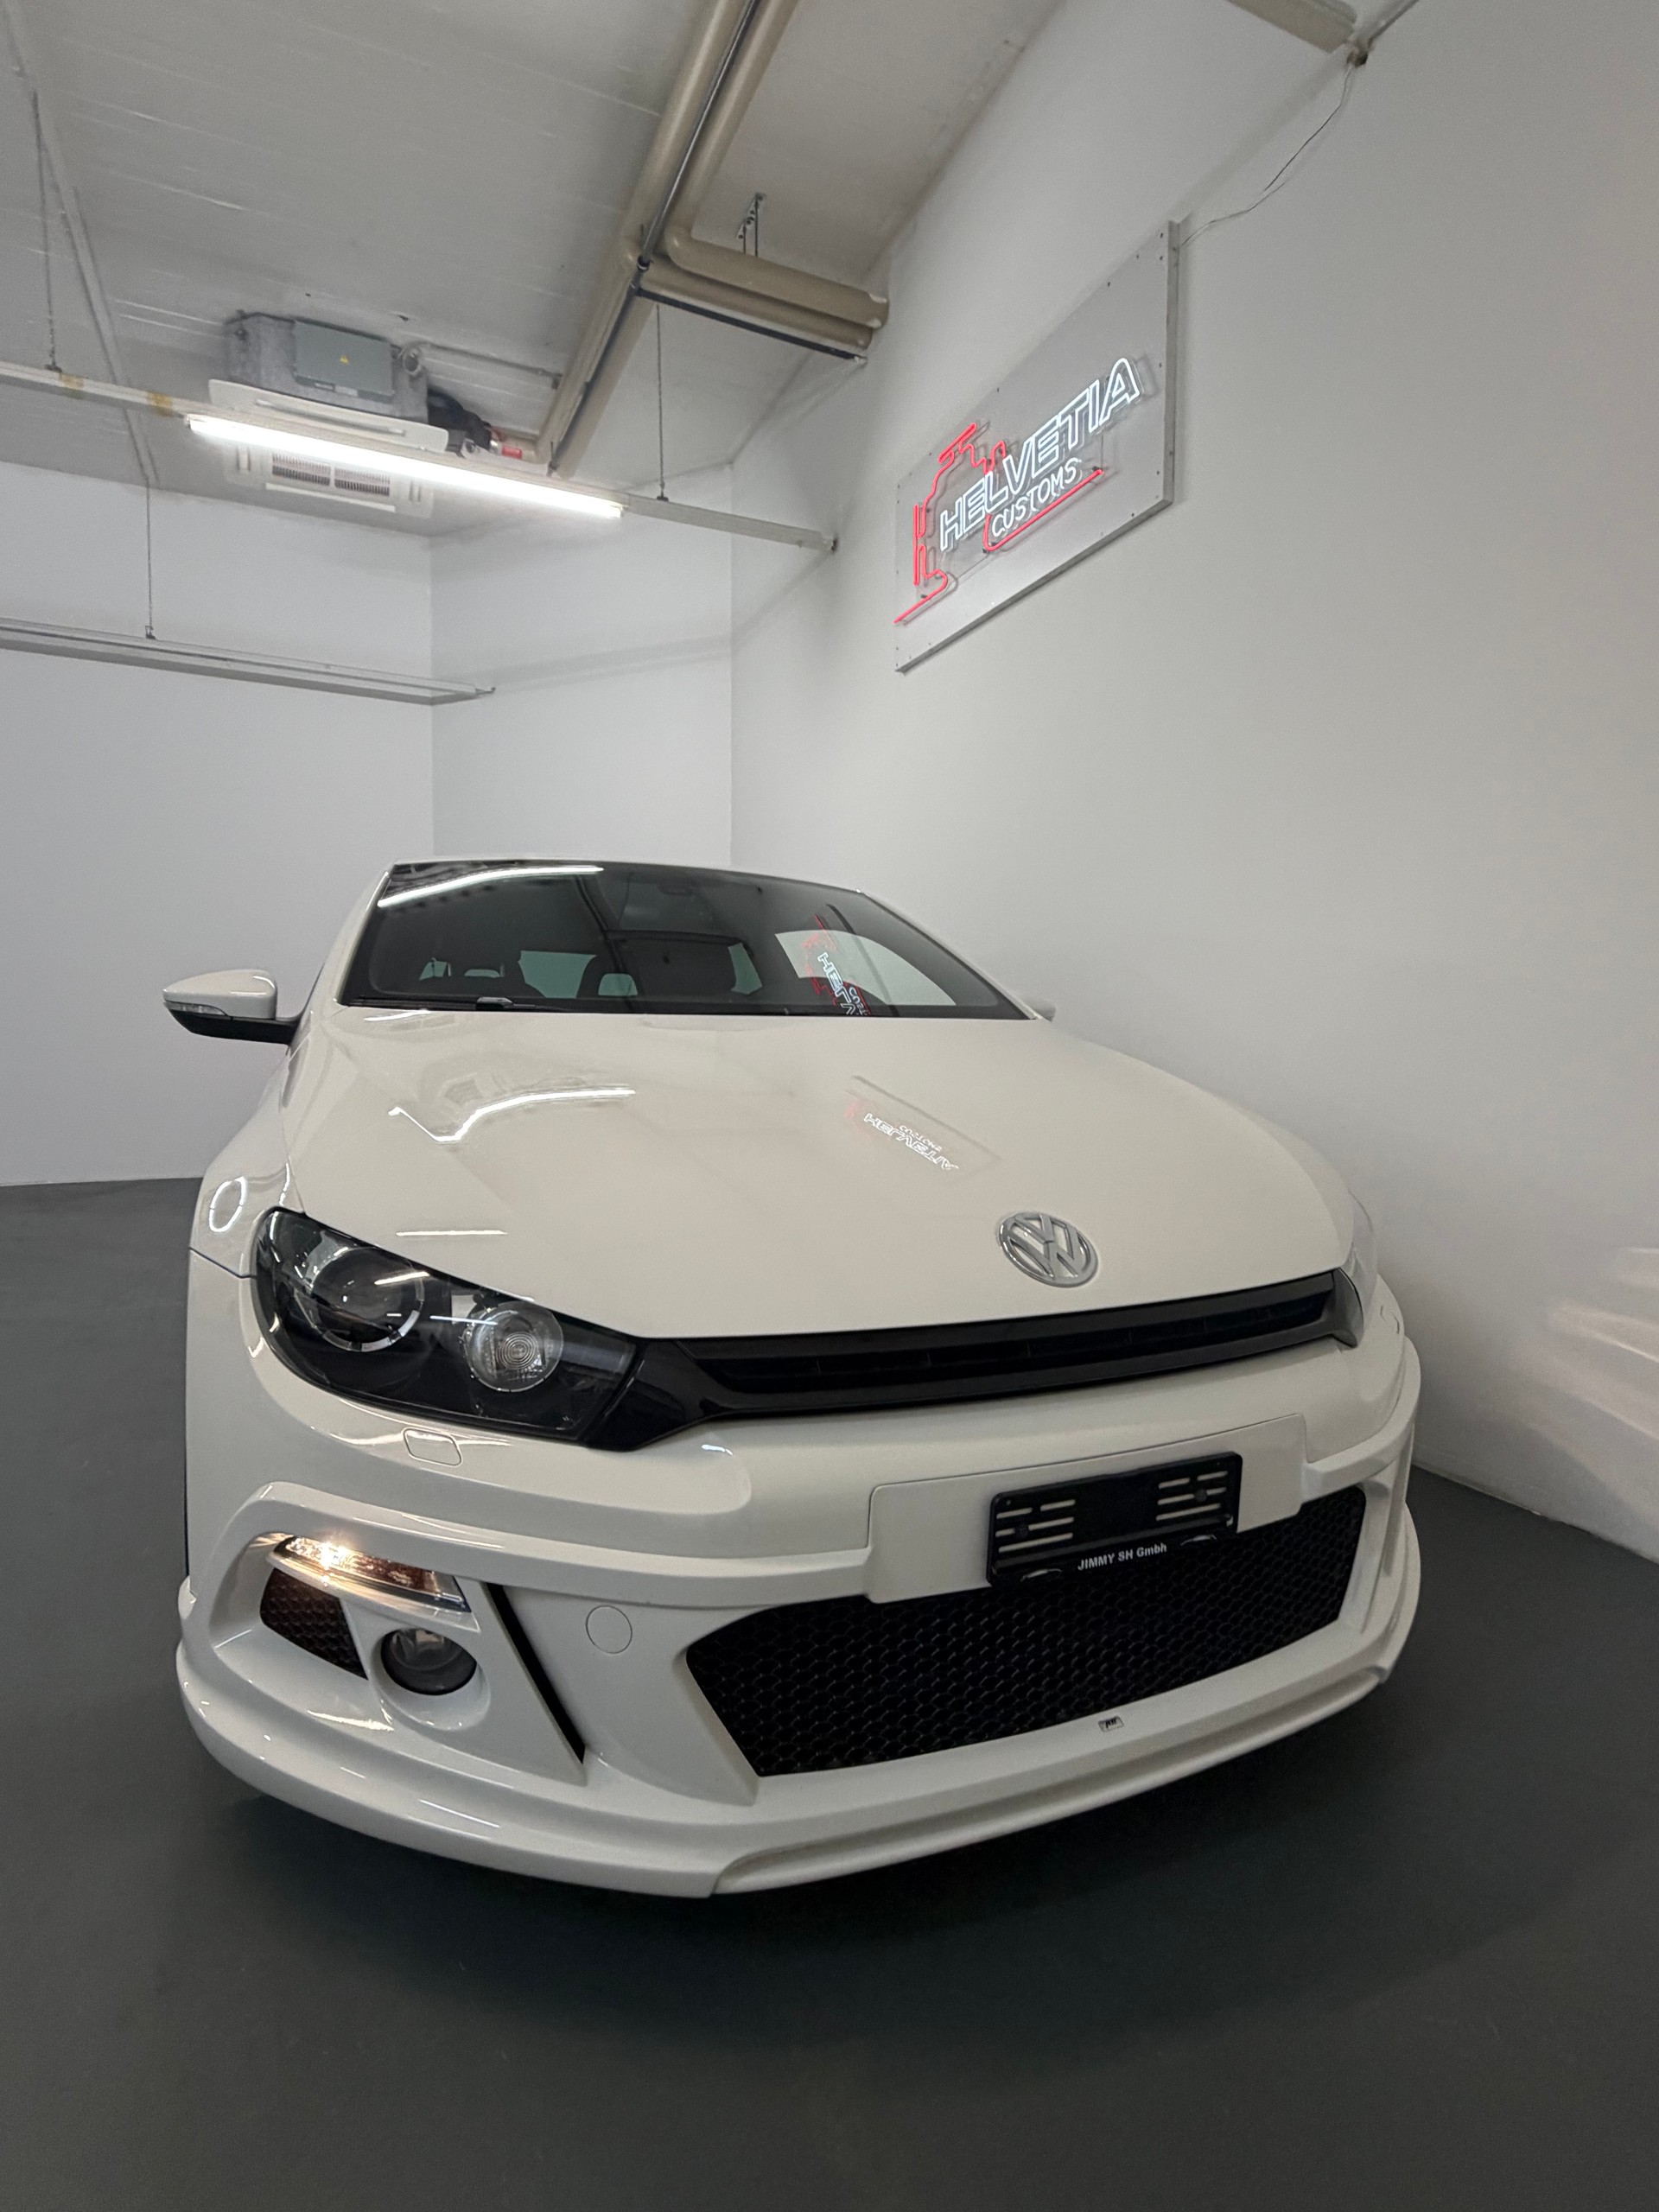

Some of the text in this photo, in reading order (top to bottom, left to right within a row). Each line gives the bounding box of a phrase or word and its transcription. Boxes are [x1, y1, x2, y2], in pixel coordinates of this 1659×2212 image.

[939, 357, 1140, 551] HELVETIA
[991, 457, 1080, 537] CUSTOMS
[1077, 1542, 1167, 1571] JIMMY SH Gmbh
